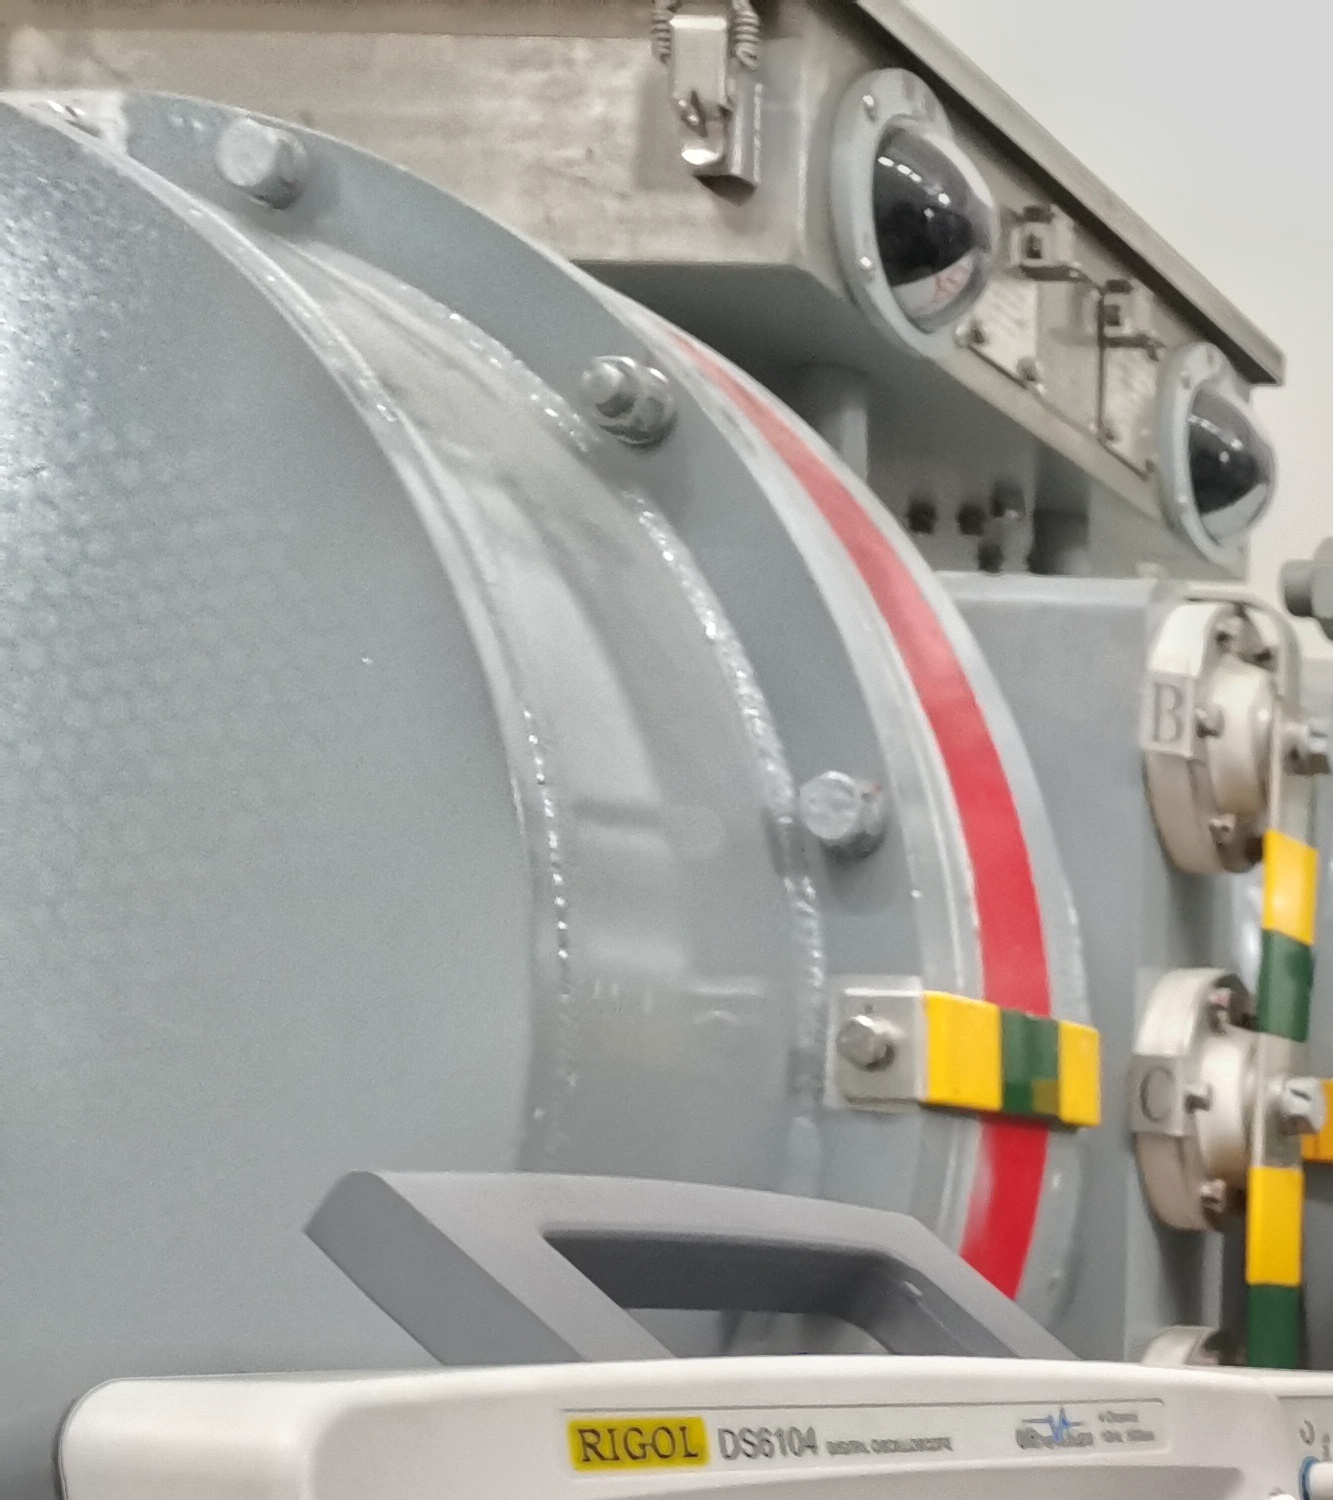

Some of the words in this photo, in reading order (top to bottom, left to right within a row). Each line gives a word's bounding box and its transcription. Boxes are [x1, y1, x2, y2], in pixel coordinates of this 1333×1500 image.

[1153, 682, 1184, 743] B
[1139, 1064, 1175, 1122] C
[577, 1426, 699, 1463] RIGOL
[717, 1426, 819, 1461] DS6104
